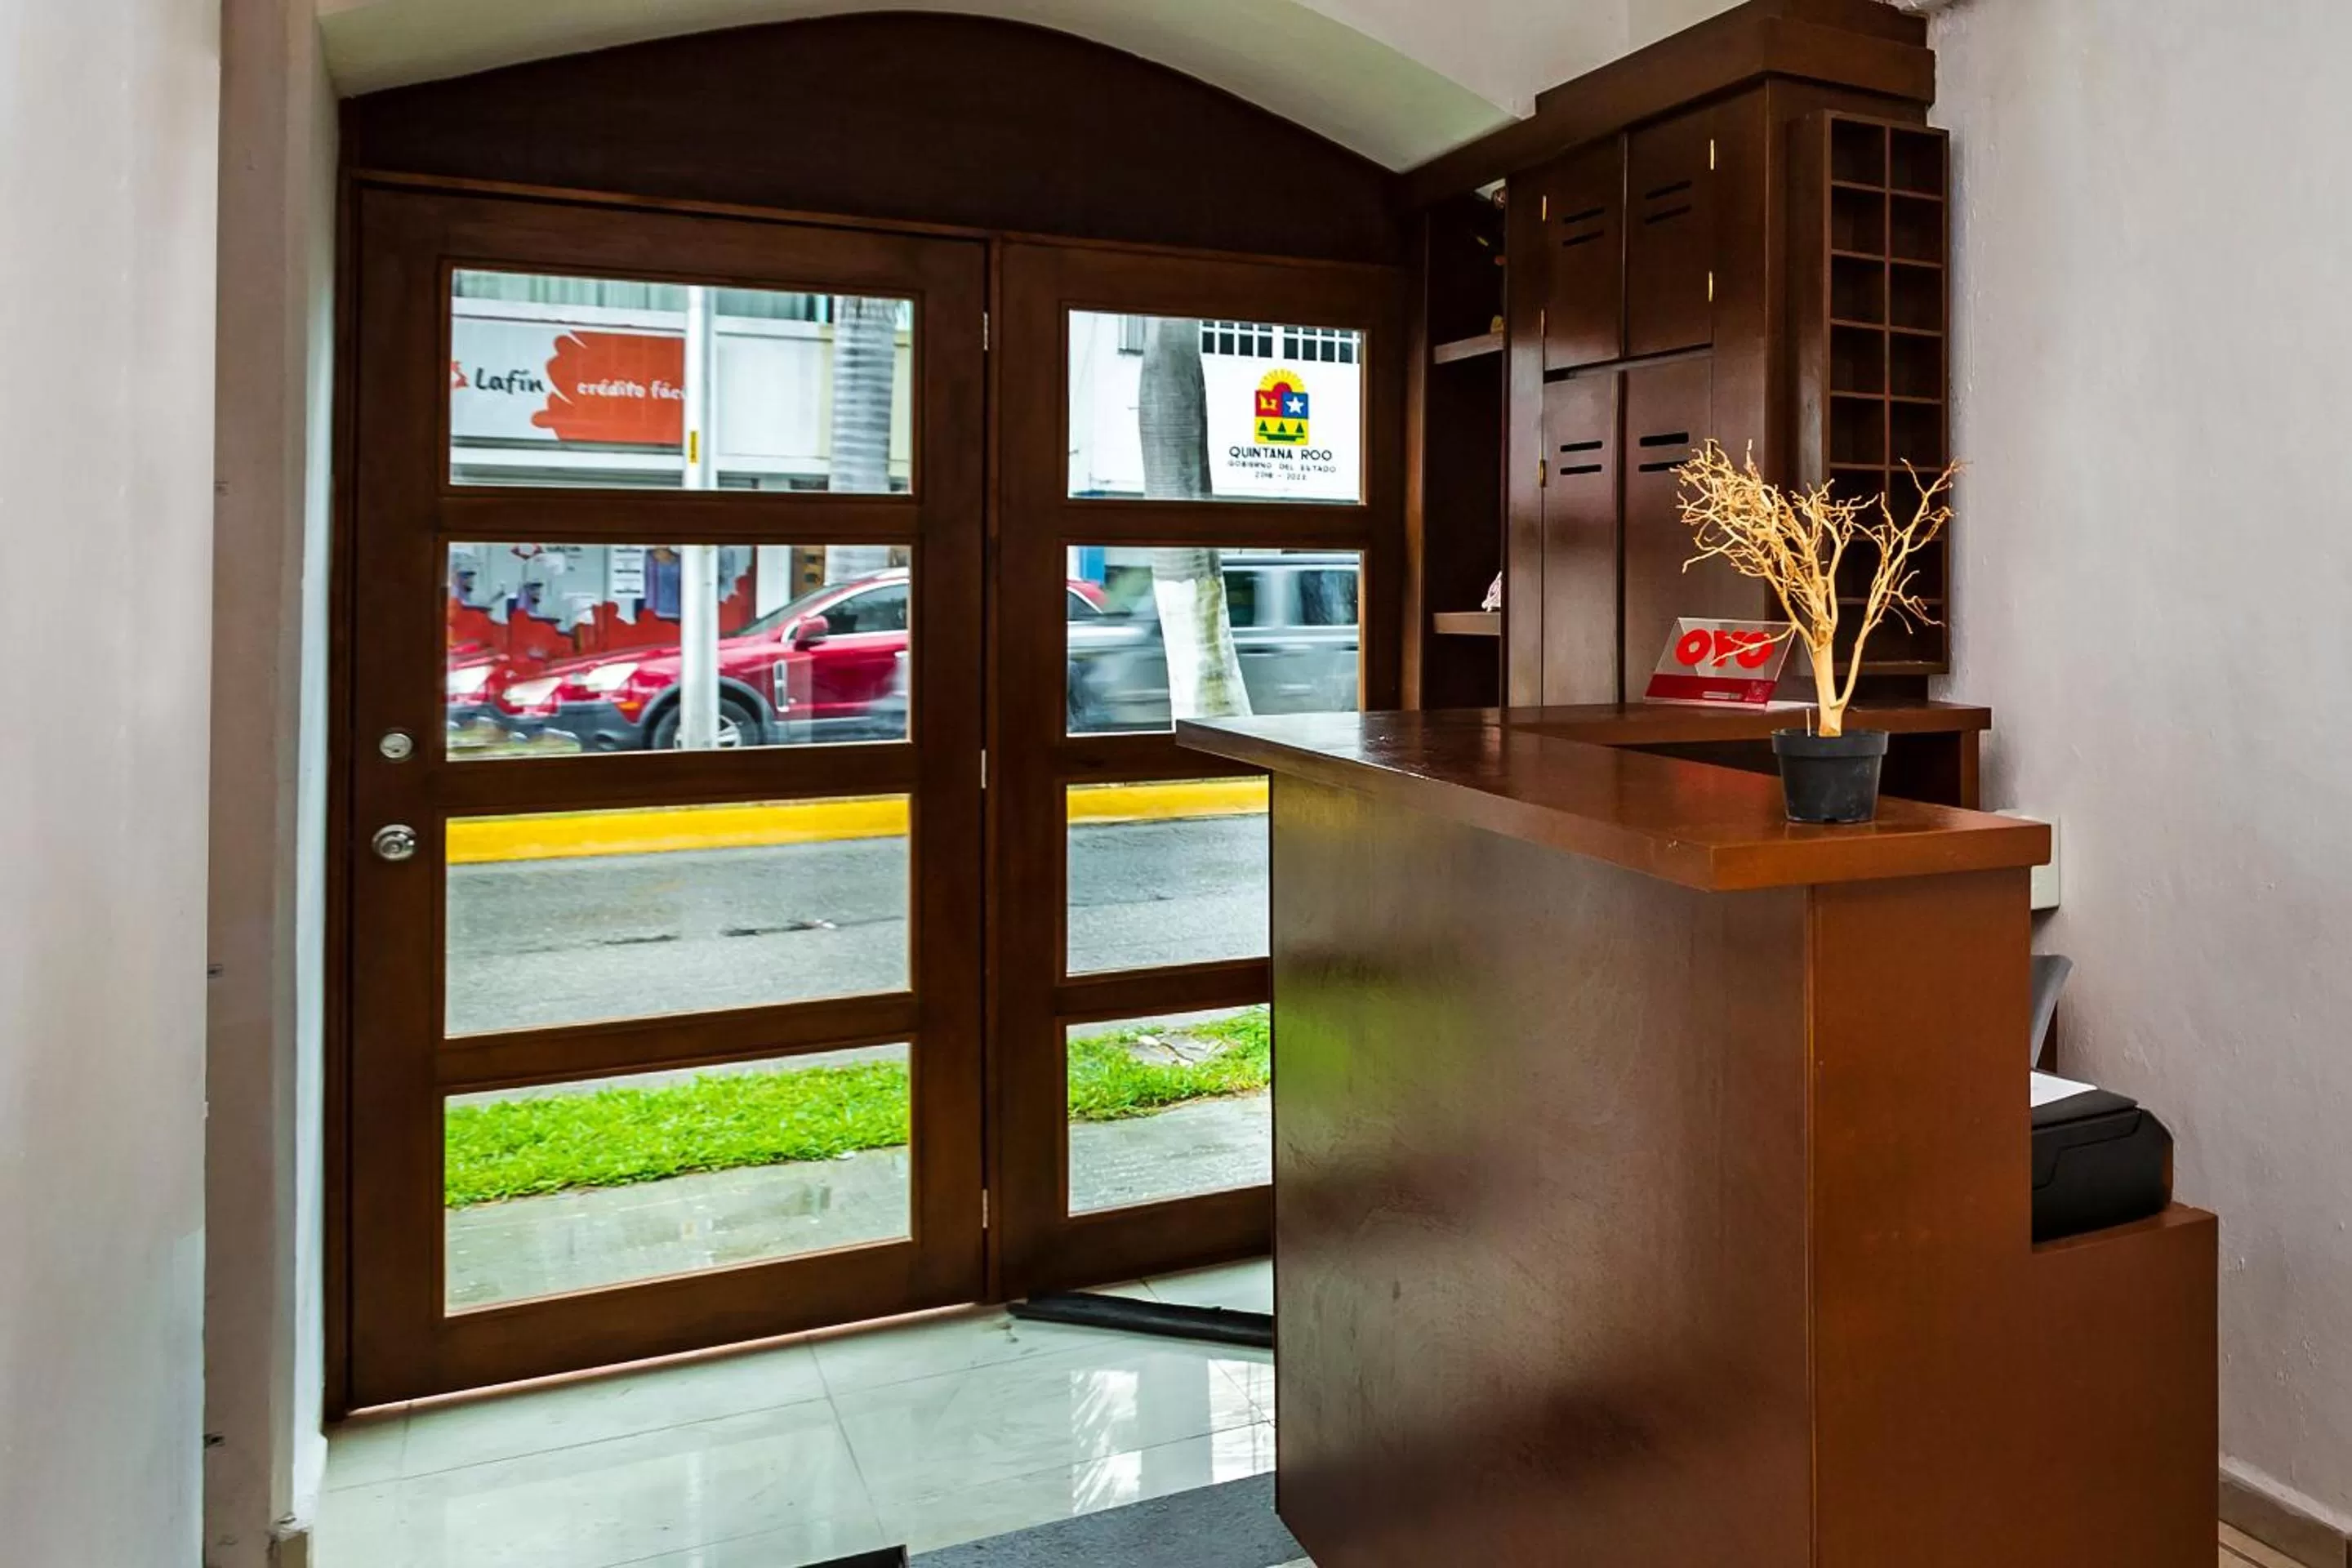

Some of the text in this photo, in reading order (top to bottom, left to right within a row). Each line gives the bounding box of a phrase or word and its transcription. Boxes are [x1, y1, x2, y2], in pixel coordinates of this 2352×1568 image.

[1229, 446, 1332, 461] QUINTANA ROO
[1227, 460, 1336, 473] GOBIERNO DEL ESTADO
[1676, 628, 1775, 669] OYO
